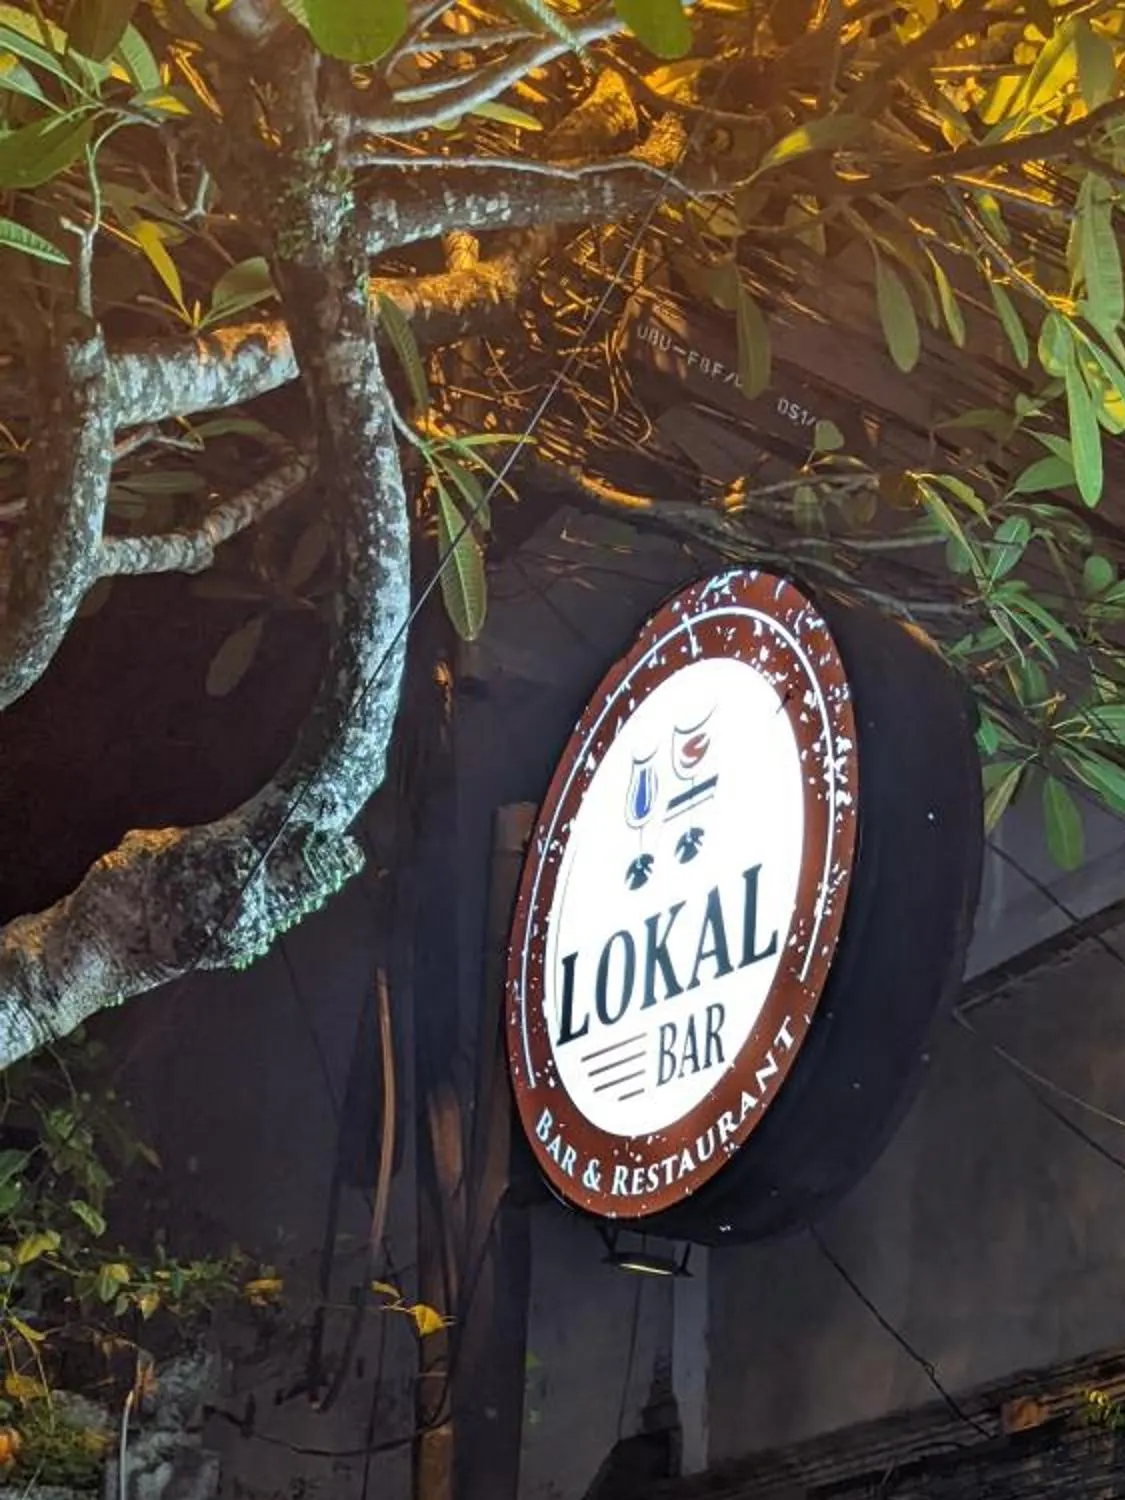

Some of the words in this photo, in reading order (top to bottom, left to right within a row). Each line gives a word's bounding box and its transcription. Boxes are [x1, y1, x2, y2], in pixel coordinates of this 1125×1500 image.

[556, 863, 779, 1047] LOKAL
[656, 1002, 726, 1088] BAR
[535, 1106, 577, 1178] BAR
[583, 1158, 602, 1192] &
[611, 1014, 795, 1196] RESTAURANT
